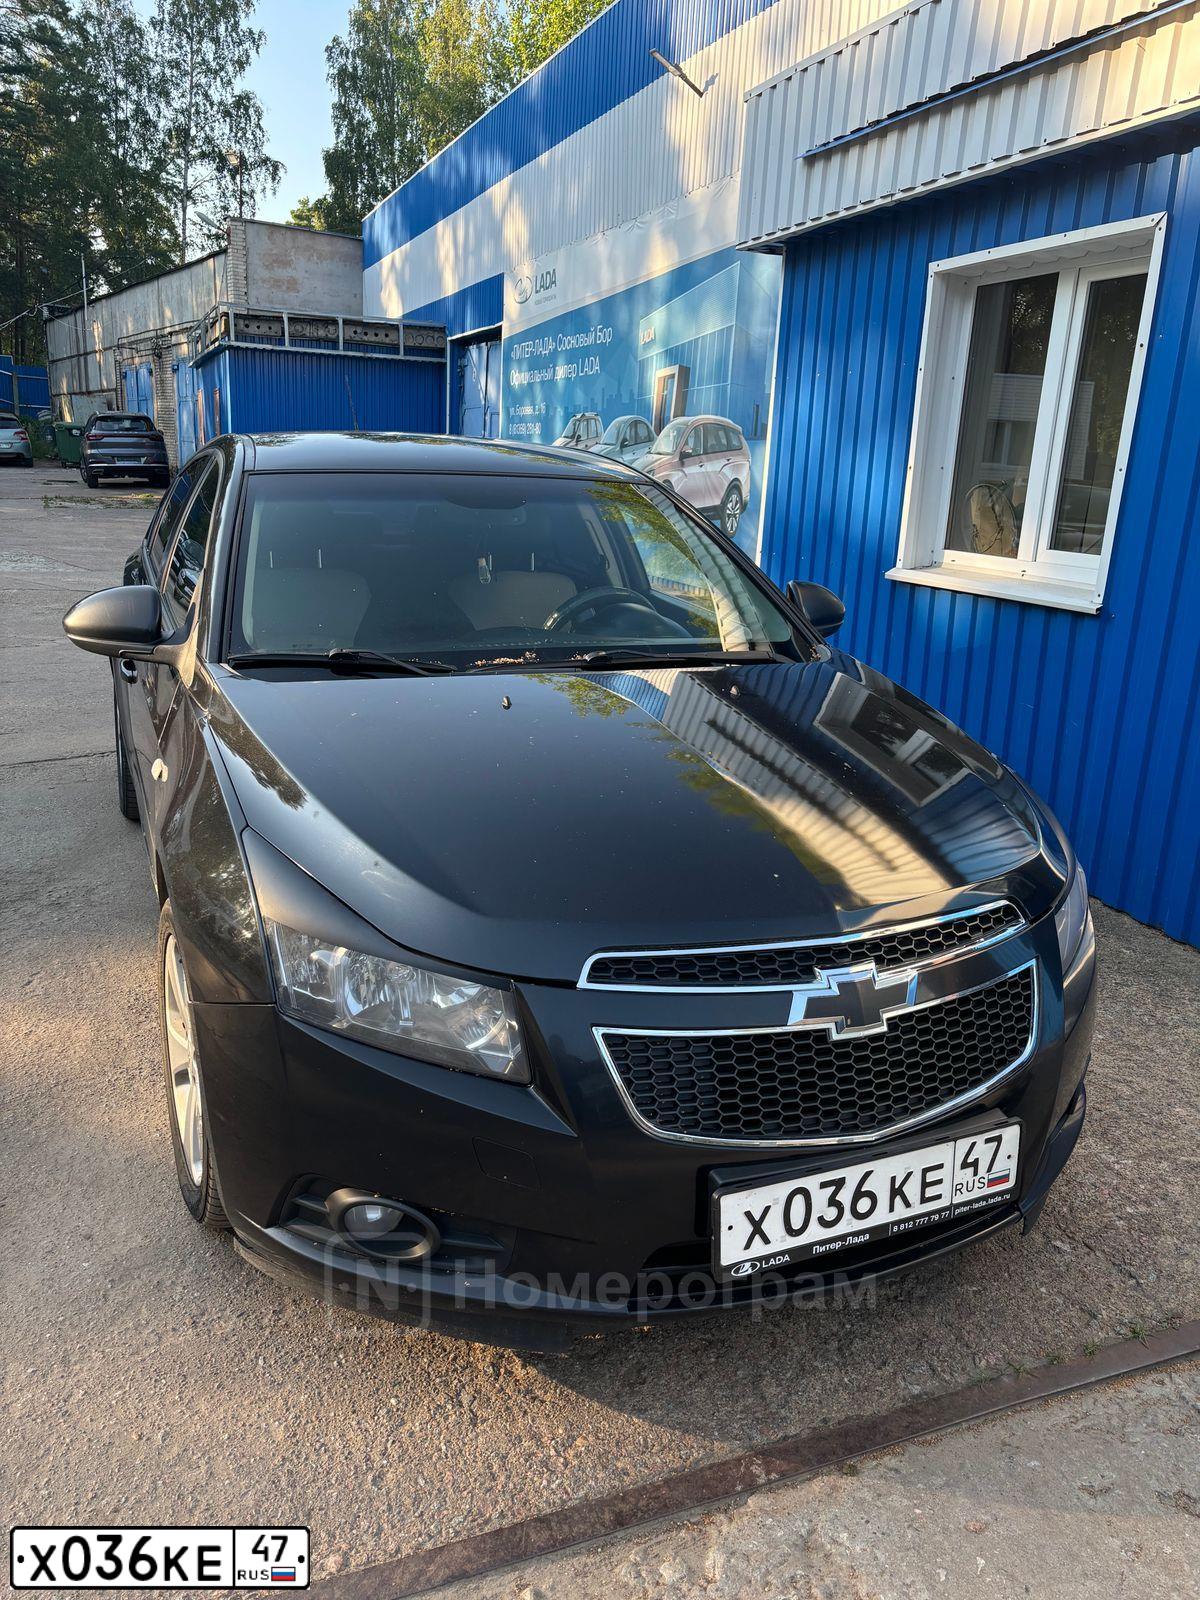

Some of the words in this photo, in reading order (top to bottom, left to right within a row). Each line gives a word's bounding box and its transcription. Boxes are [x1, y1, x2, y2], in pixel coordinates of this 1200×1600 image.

[535, 268, 557, 294] LADA
[511, 336, 556, 361] «ПИТЕР-ЛАДА»
[557, 326, 595, 352] Сосновый
[596, 325, 613, 347] Бор
[510, 365, 554, 388] Официальный
[554, 363, 577, 382] дилер
[578, 356, 601, 376] LADA
[743, 1162, 945, 1251] Х036КЕ
[960, 1133, 1003, 1177] 47
[954, 1176, 986, 1197] RUS
[955, 1193, 1011, 1216] piter-lada.lada.ru
[899, 1221, 914, 1231] 812
[915, 1216, 929, 1227] 777
[930, 1213, 939, 1222] 79
[941, 1210, 950, 1219] 77
[812, 1232, 870, 1255] Питер-Лада
[762, 1254, 791, 1268] LADA
